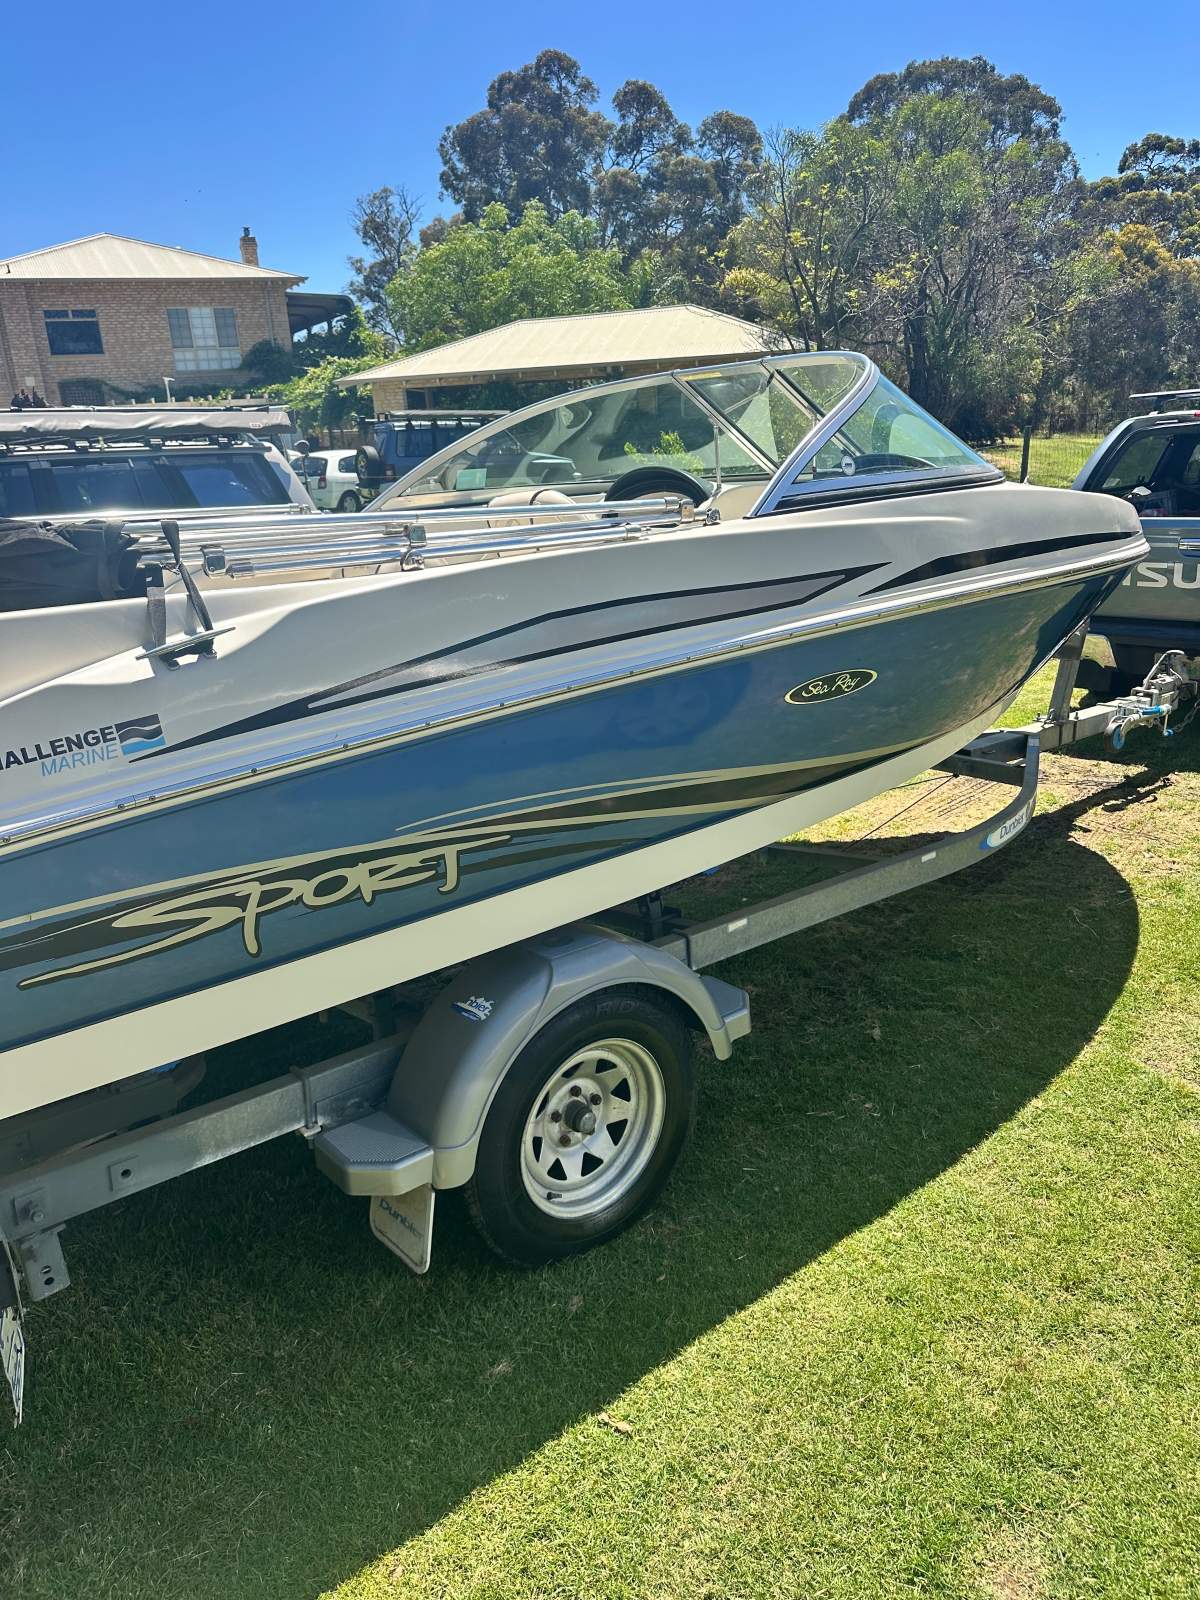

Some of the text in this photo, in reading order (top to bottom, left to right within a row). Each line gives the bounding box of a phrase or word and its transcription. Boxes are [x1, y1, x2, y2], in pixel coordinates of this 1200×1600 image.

[802, 673, 861, 697] Sea Ray
[40, 742, 119, 777] MARINE
[18, 833, 512, 989] SPORT
